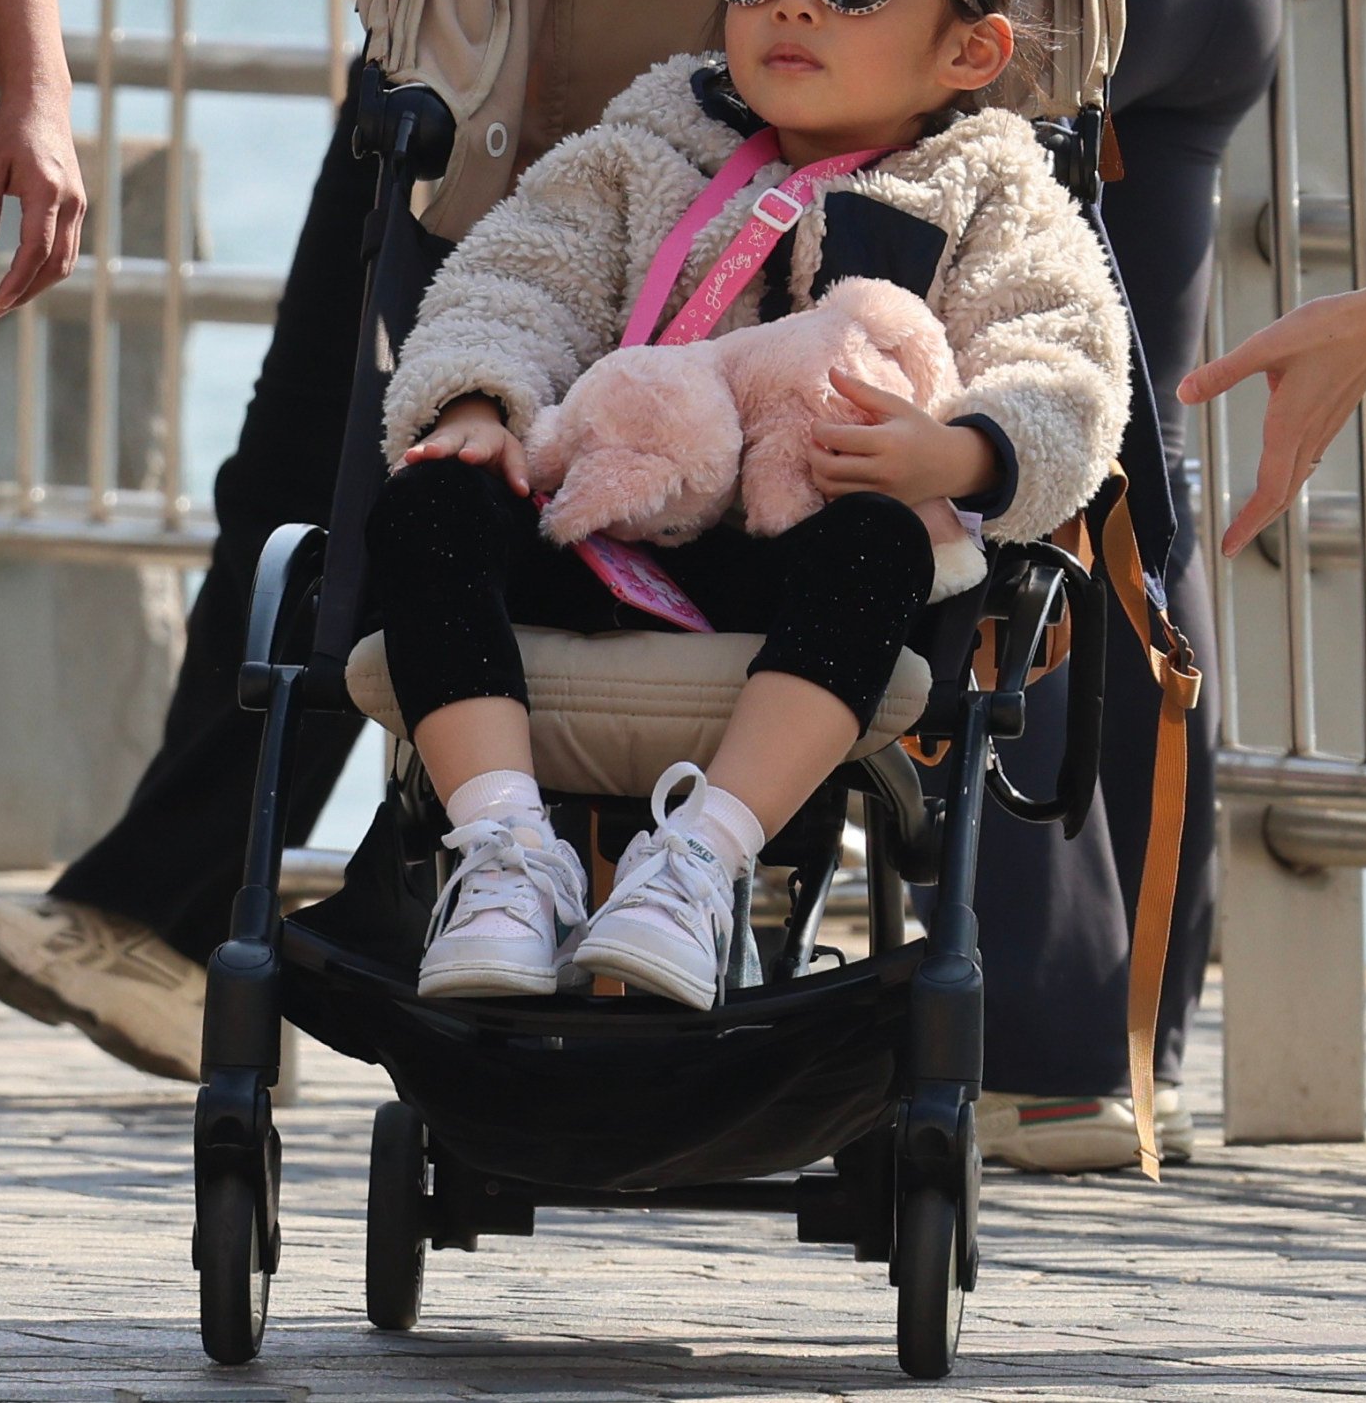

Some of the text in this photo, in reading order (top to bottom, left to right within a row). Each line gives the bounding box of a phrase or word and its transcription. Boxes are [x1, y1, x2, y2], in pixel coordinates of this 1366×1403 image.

[705, 253, 751, 309] Hello Kitty
[687, 838, 712, 860] NIKE
